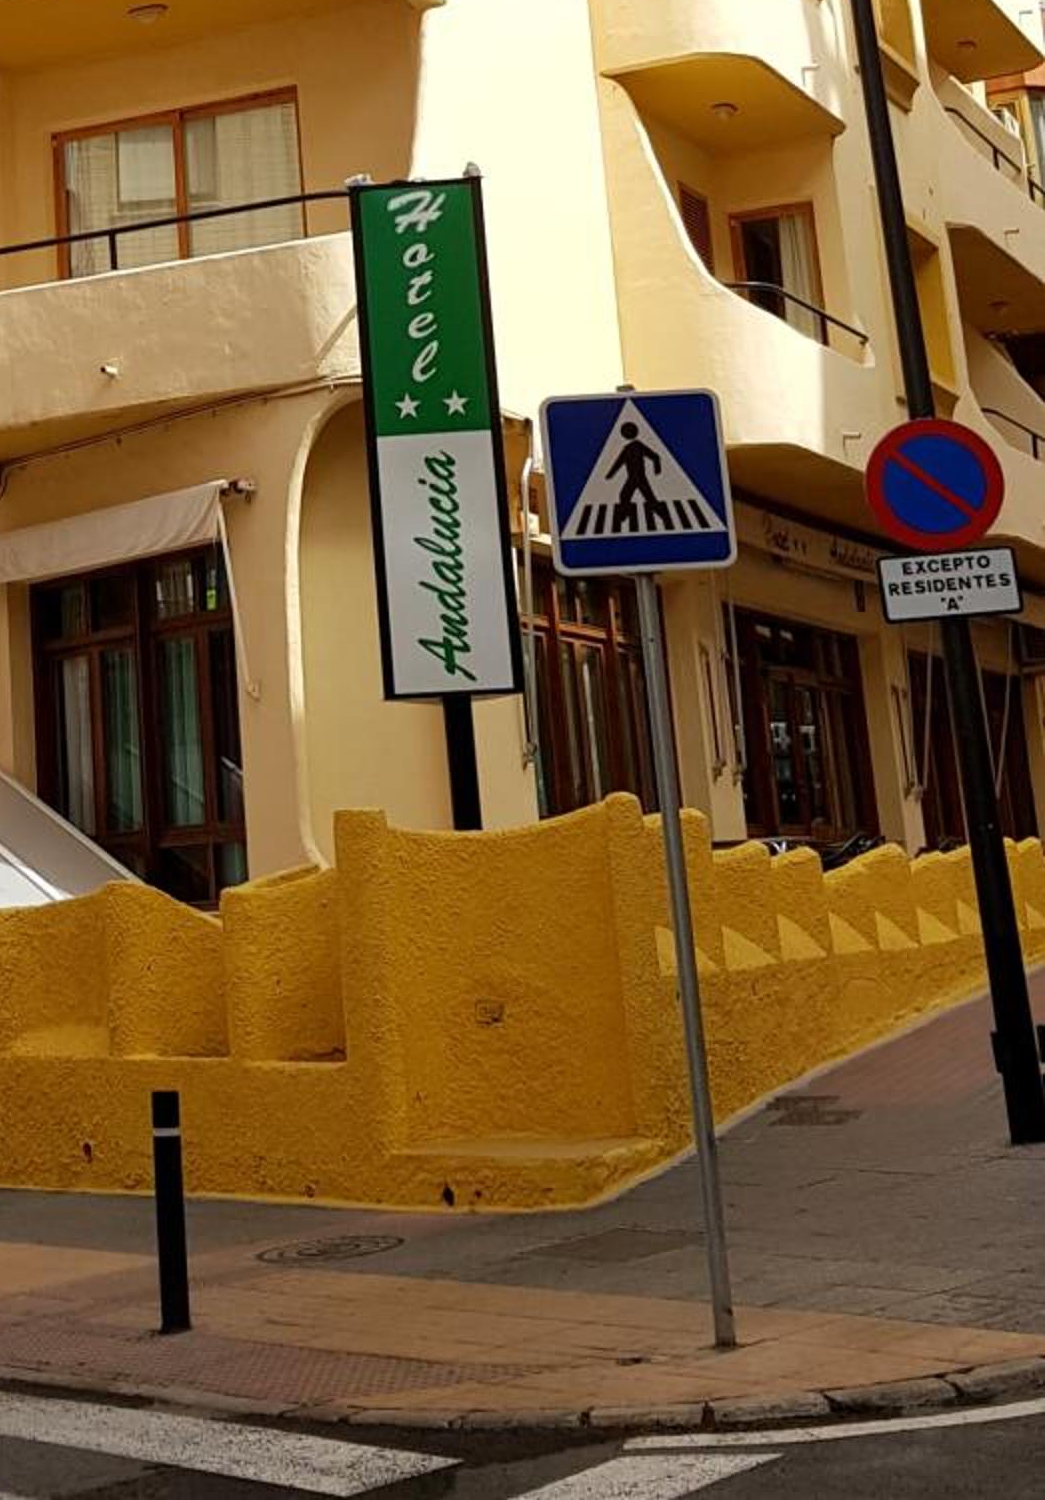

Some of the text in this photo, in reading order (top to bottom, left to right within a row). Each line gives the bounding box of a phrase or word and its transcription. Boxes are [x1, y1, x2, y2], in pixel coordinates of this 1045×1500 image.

[387, 190, 446, 382] Hotel
[902, 555, 991, 575] EXCEPTO
[888, 573, 1012, 596] RESIDENTES
